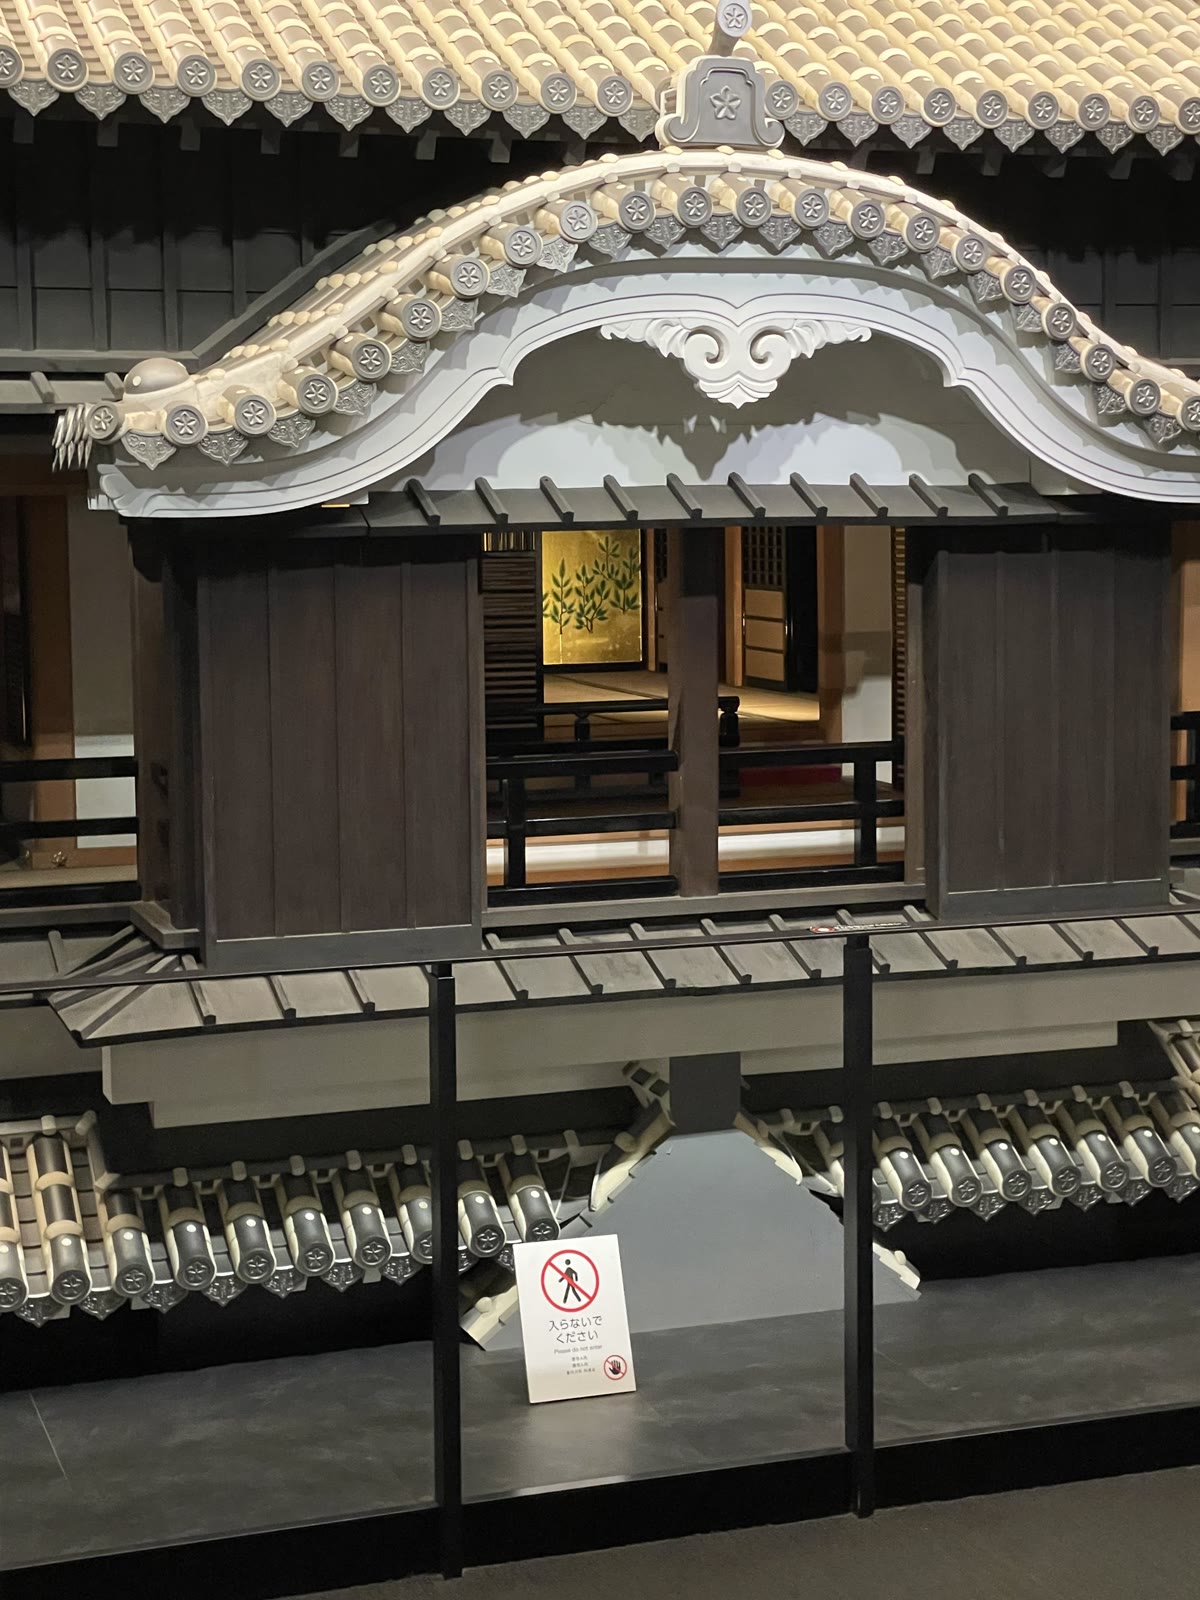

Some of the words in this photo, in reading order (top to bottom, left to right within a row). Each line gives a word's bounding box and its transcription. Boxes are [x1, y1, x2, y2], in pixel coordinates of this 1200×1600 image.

[549, 1315, 602, 1331] 入らないで
[556, 1330, 598, 1343] ください
